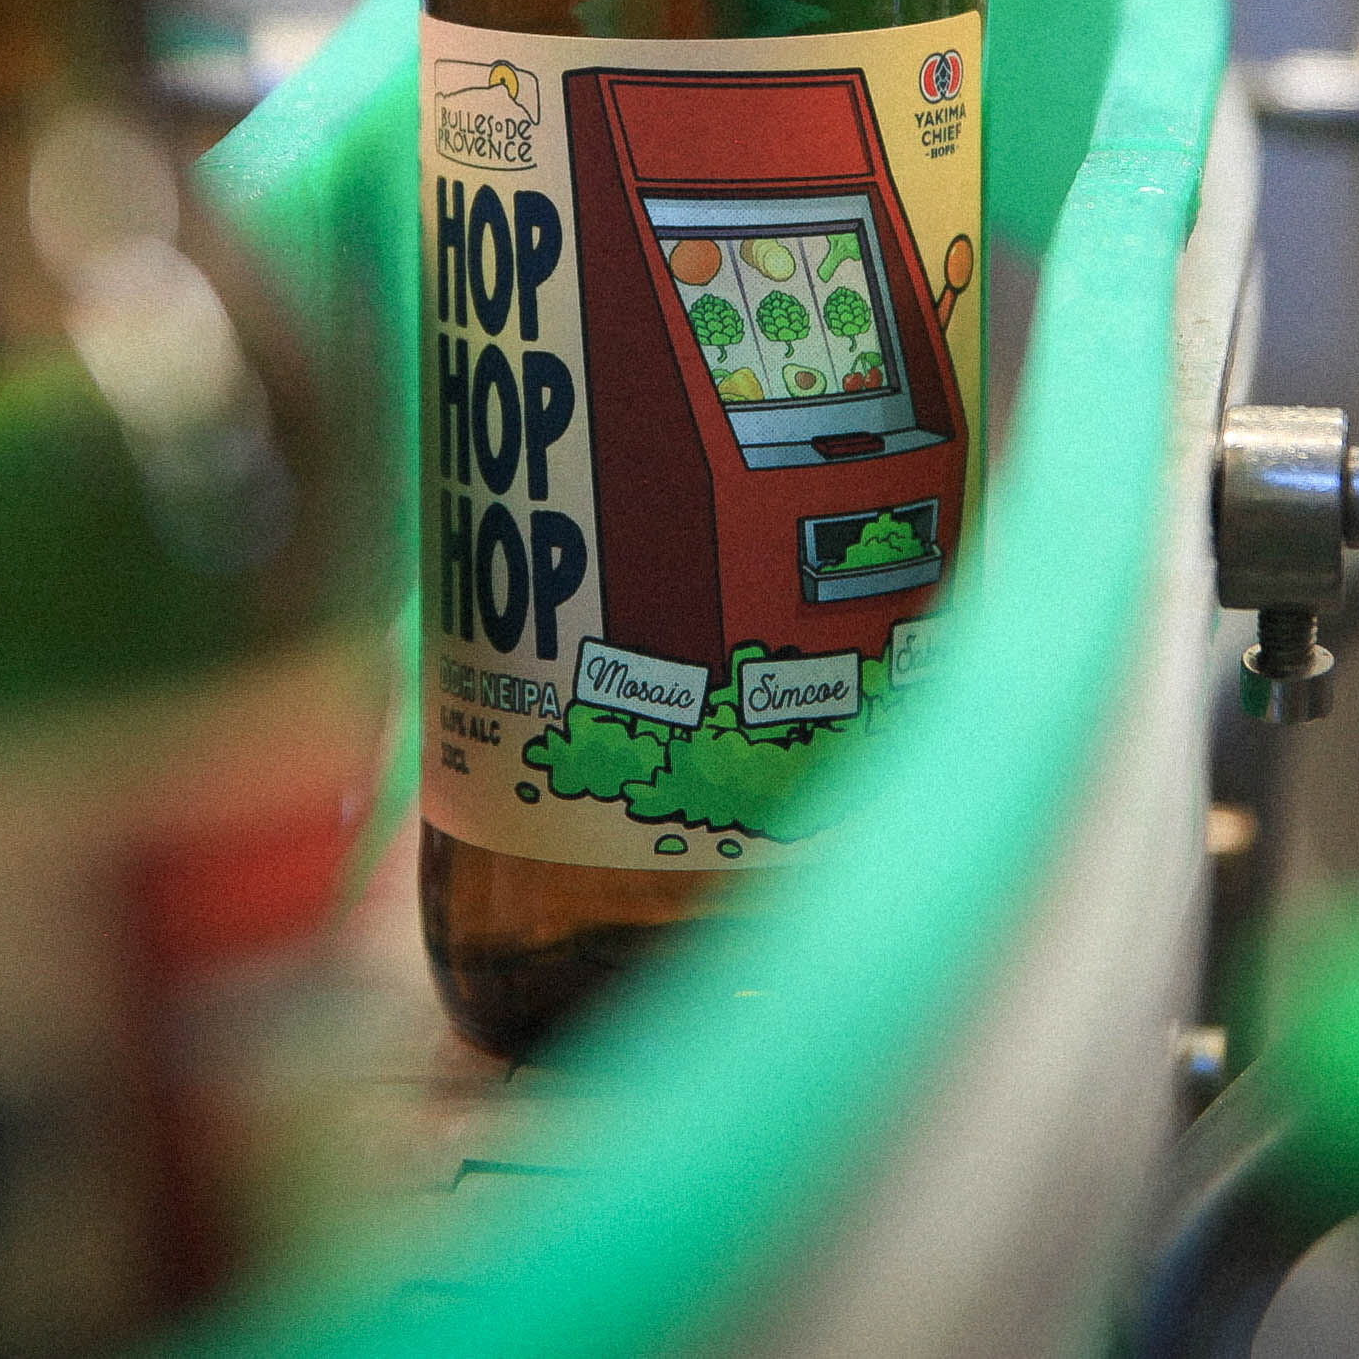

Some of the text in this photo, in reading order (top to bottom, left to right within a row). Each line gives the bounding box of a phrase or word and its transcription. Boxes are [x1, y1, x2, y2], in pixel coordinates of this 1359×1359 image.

[913, 102, 967, 129] YAKIMA
[921, 122, 963, 147] CHIEF
[437, 175, 563, 342] HOP
[438, 332, 576, 502] HOP
[441, 488, 588, 661] HOP
[480, 670, 562, 720] NEIPA
[586, 655, 696, 709] Mosaic
[748, 673, 850, 713] Simcoe
